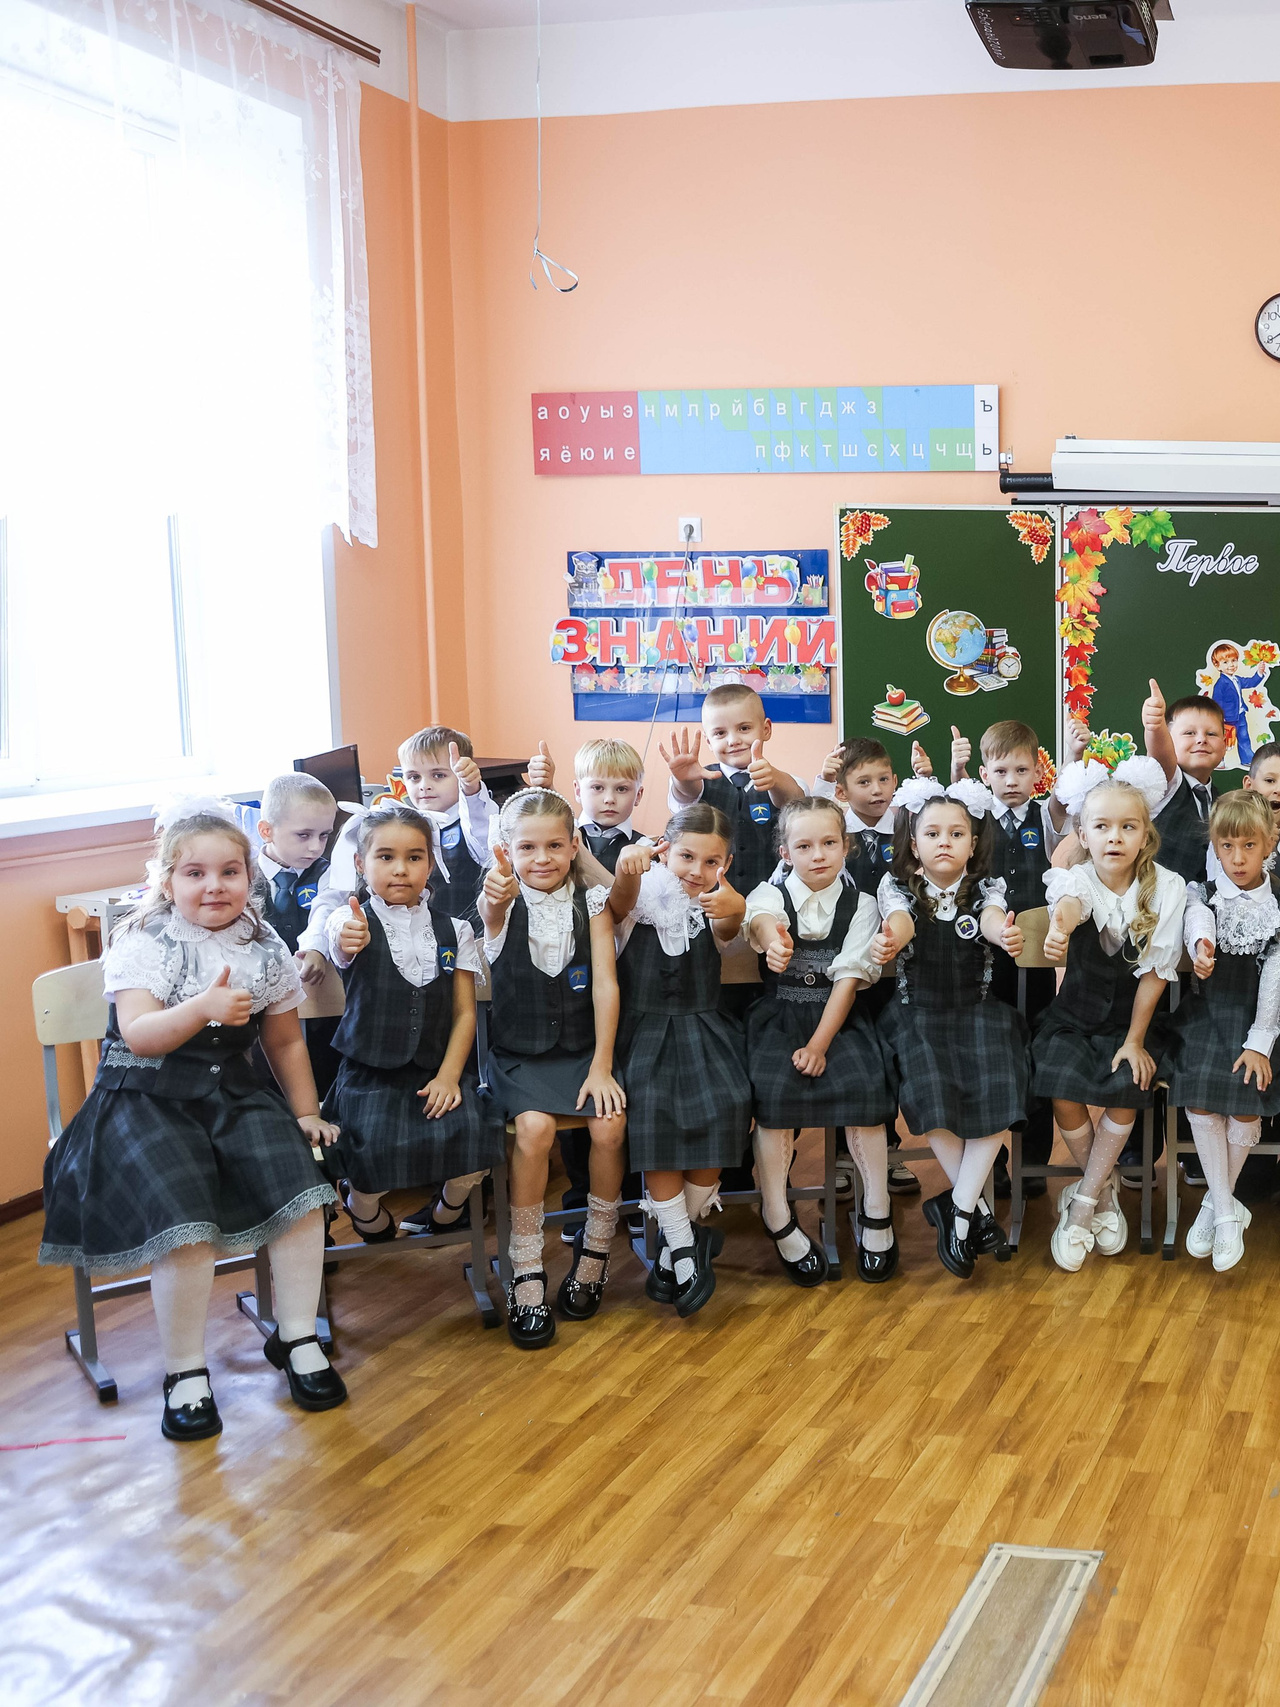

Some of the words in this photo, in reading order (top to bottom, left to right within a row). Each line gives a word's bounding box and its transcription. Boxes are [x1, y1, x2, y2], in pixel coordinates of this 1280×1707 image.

[1263, 323, 1270, 332] 9
[1267, 312, 1277, 321] 10
[1275, 343, 1280, 352] 7
[537, 406, 548, 419] а
[558, 406, 569, 419] о
[580, 405, 590, 423] у
[600, 405, 613, 418] ы
[622, 405, 633, 418] э
[645, 405, 655, 417] н
[665, 404, 677, 416] м
[687, 404, 698, 416] л
[710, 403, 720, 420] р
[732, 399, 742, 416] й
[753, 398, 764, 415] б
[776, 402, 786, 415] в
[800, 402, 807, 415] г
[819, 402, 832, 417] д
[841, 401, 856, 414] ж
[867, 401, 876, 414] з
[540, 448, 550, 461] я
[560, 446, 571, 463] ё
[580, 447, 594, 460] ю
[603, 447, 613, 460] и
[624, 447, 635, 460] е
[755, 445, 765, 458] п
[774, 441, 790, 461] ф
[800, 445, 809, 457] к
[822, 444, 831, 457] т
[842, 444, 857, 456] ш
[867, 444, 877, 456] с
[890, 444, 900, 456] х
[912, 444, 924, 459] ц
[935, 444, 946, 456] ч
[956, 443, 972, 459] щ
[1159, 541, 1258, 585] Первое
[604, 557, 799, 606] ДЕНЬ
[553, 616, 838, 665] ЗНАНИЙ
